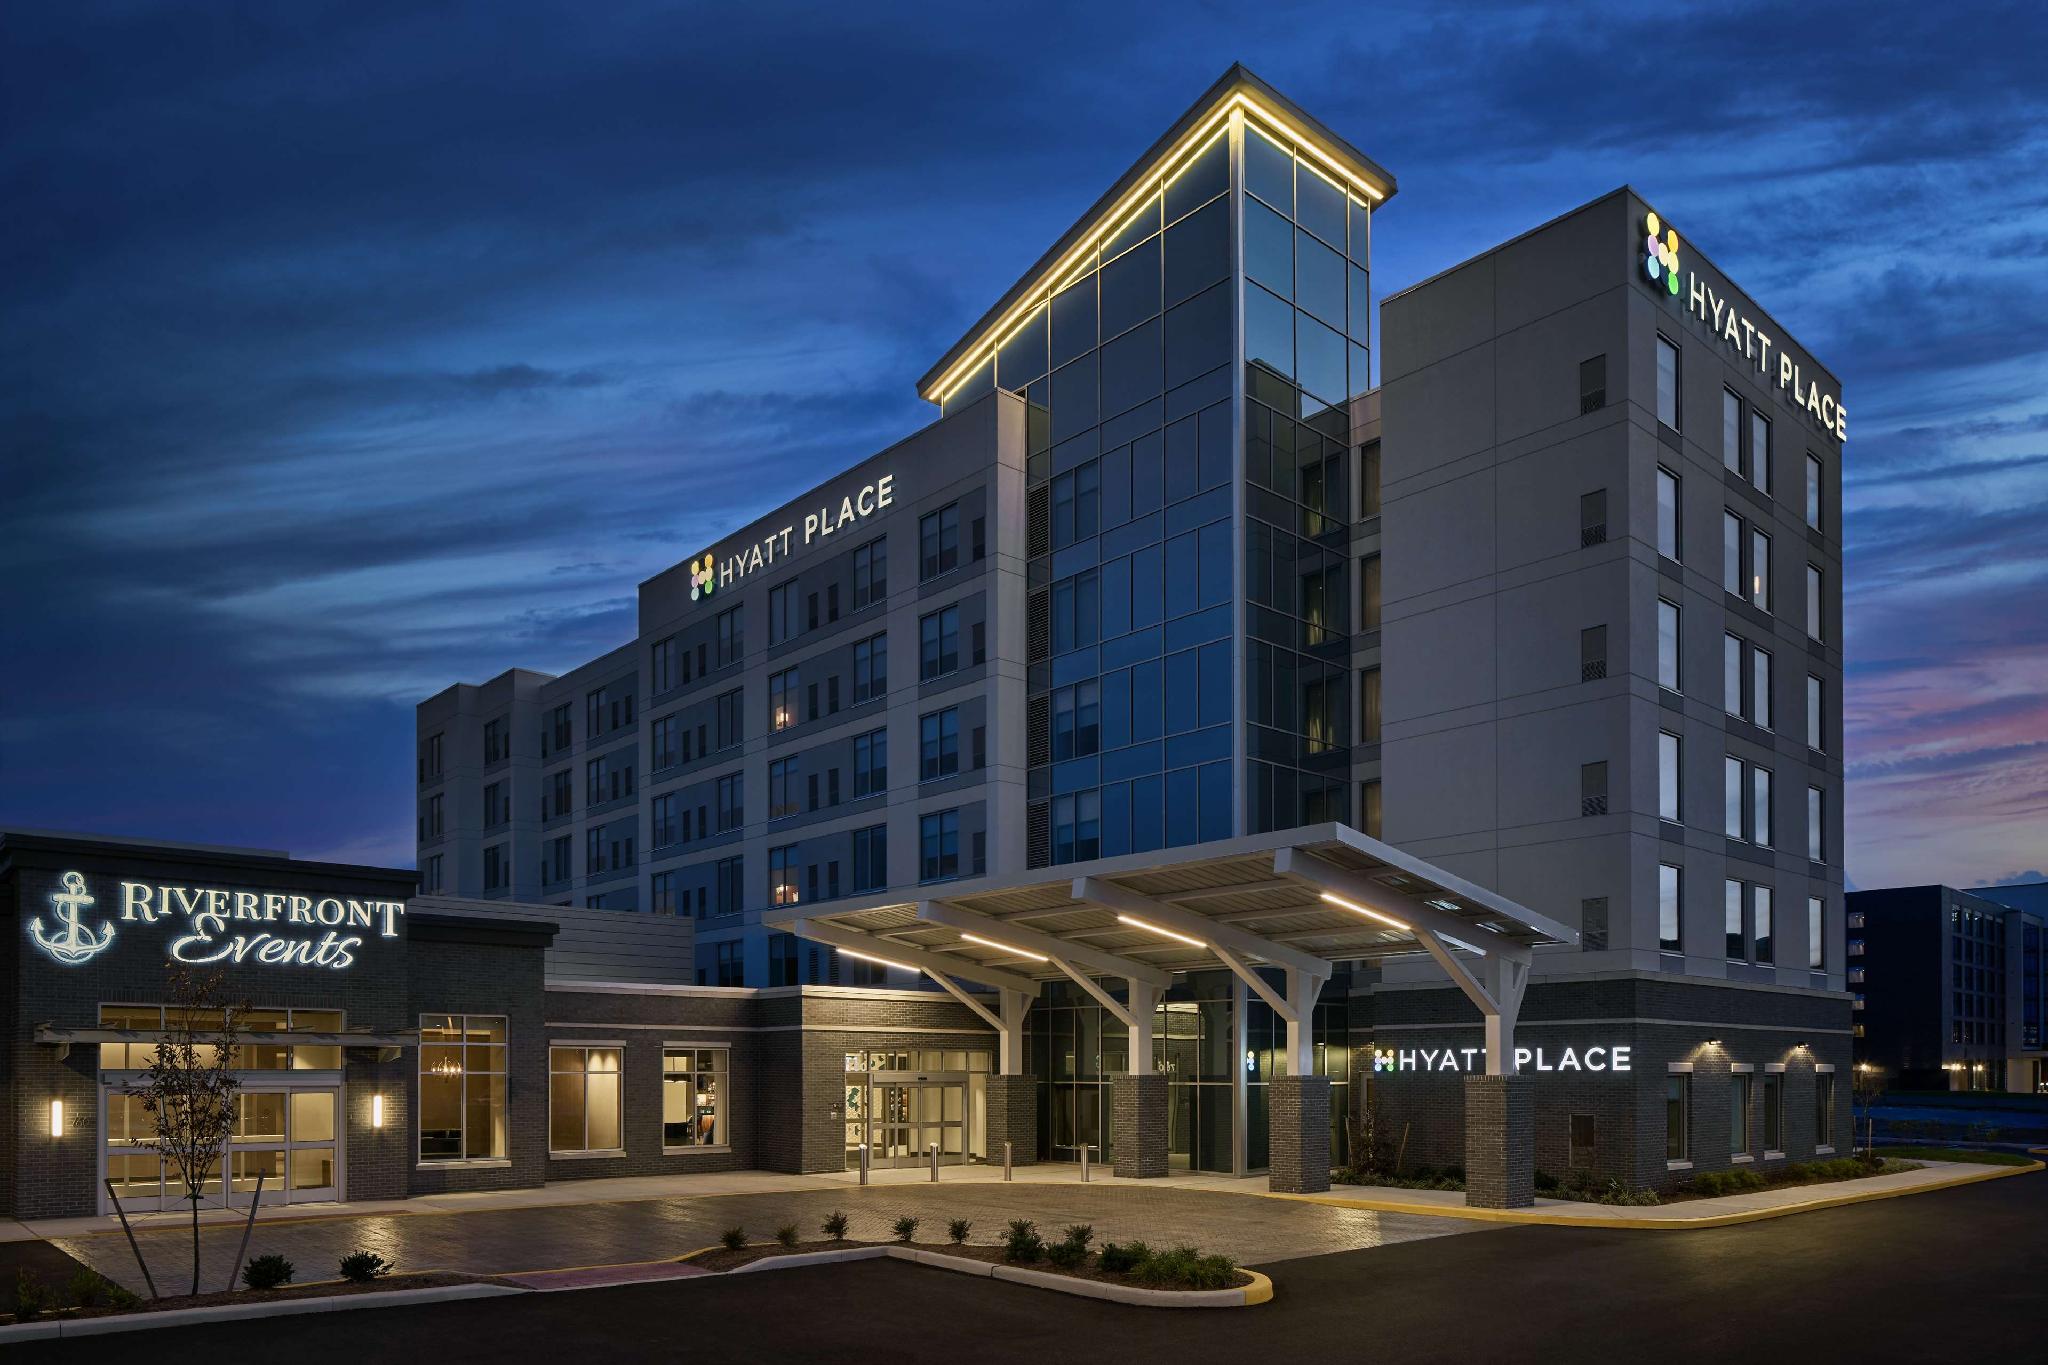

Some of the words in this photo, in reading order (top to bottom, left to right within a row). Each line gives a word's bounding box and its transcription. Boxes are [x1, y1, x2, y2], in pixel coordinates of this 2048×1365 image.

[1690, 271, 1771, 372] HYATT
[1780, 352, 1847, 442] PLACE
[720, 526, 793, 588] HYATT
[805, 474, 893, 544] PLACE
[120, 881, 405, 938] RIVERFRONT
[171, 912, 362, 969] Events
[1400, 1049, 1487, 1071] HYAT
[1514, 1046, 1631, 1071] PLACE
